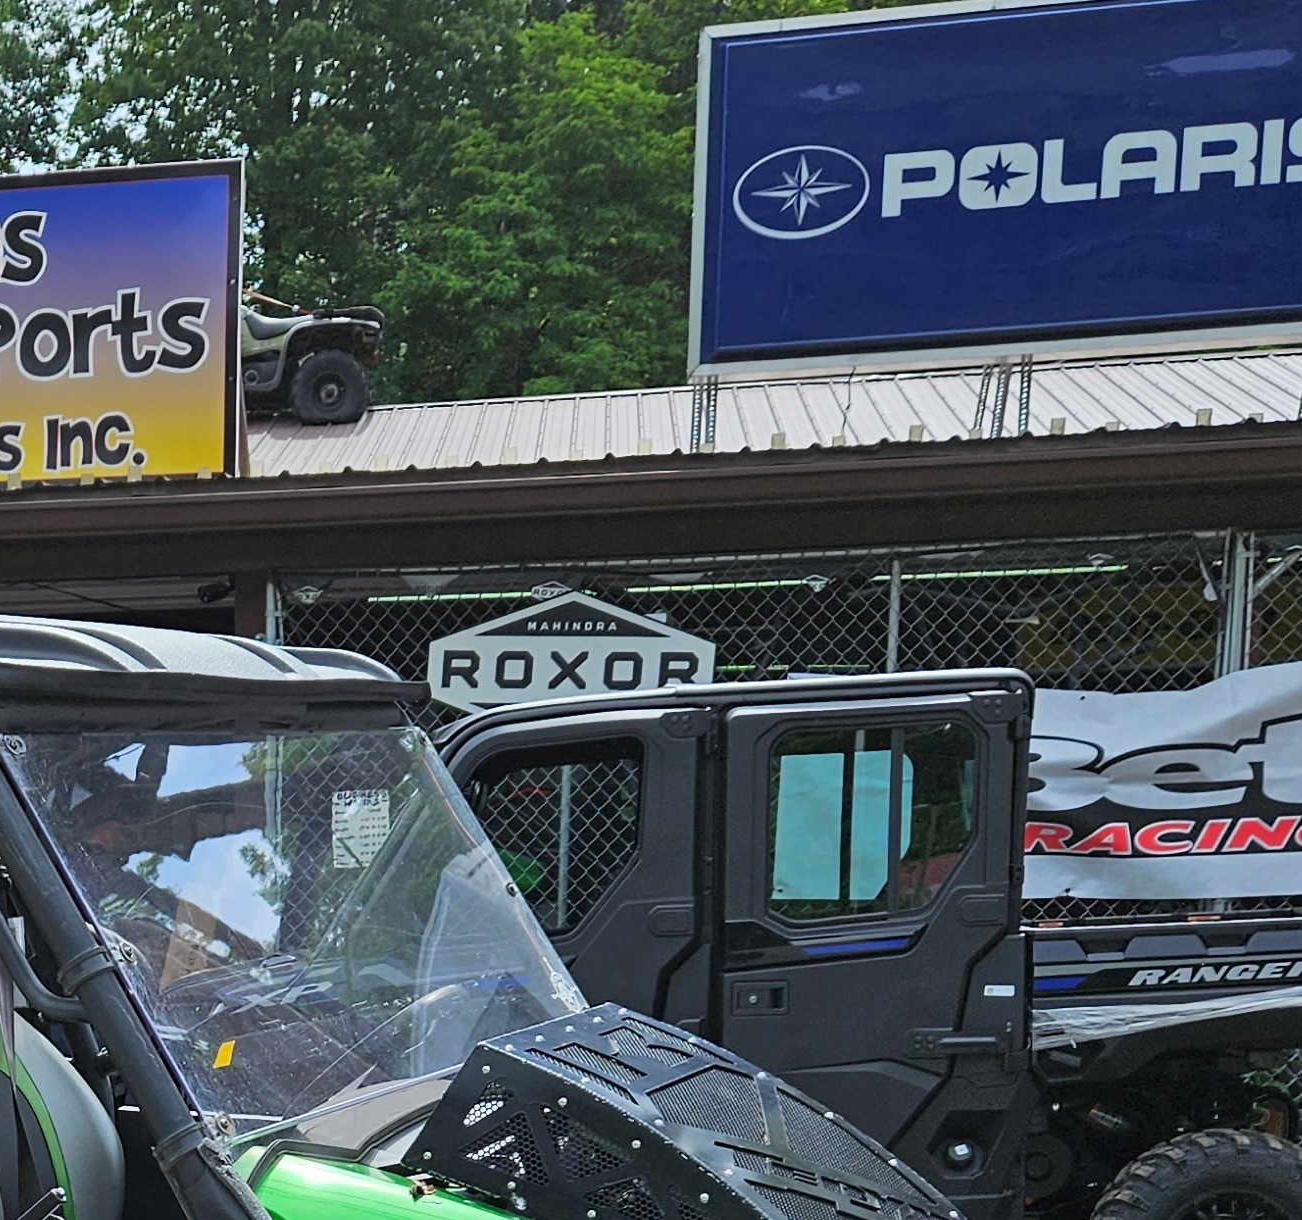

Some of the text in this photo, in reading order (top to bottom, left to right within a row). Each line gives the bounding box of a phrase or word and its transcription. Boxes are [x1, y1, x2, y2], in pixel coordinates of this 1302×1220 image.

[881, 118, 1302, 218] POLARI
[44, 411, 147, 473] Inc.
[527, 620, 618, 632] MAHINDRA
[441, 650, 699, 690] ROXOR
[1025, 815, 1302, 855] RACIN
[1128, 961, 1302, 987] RANGE
